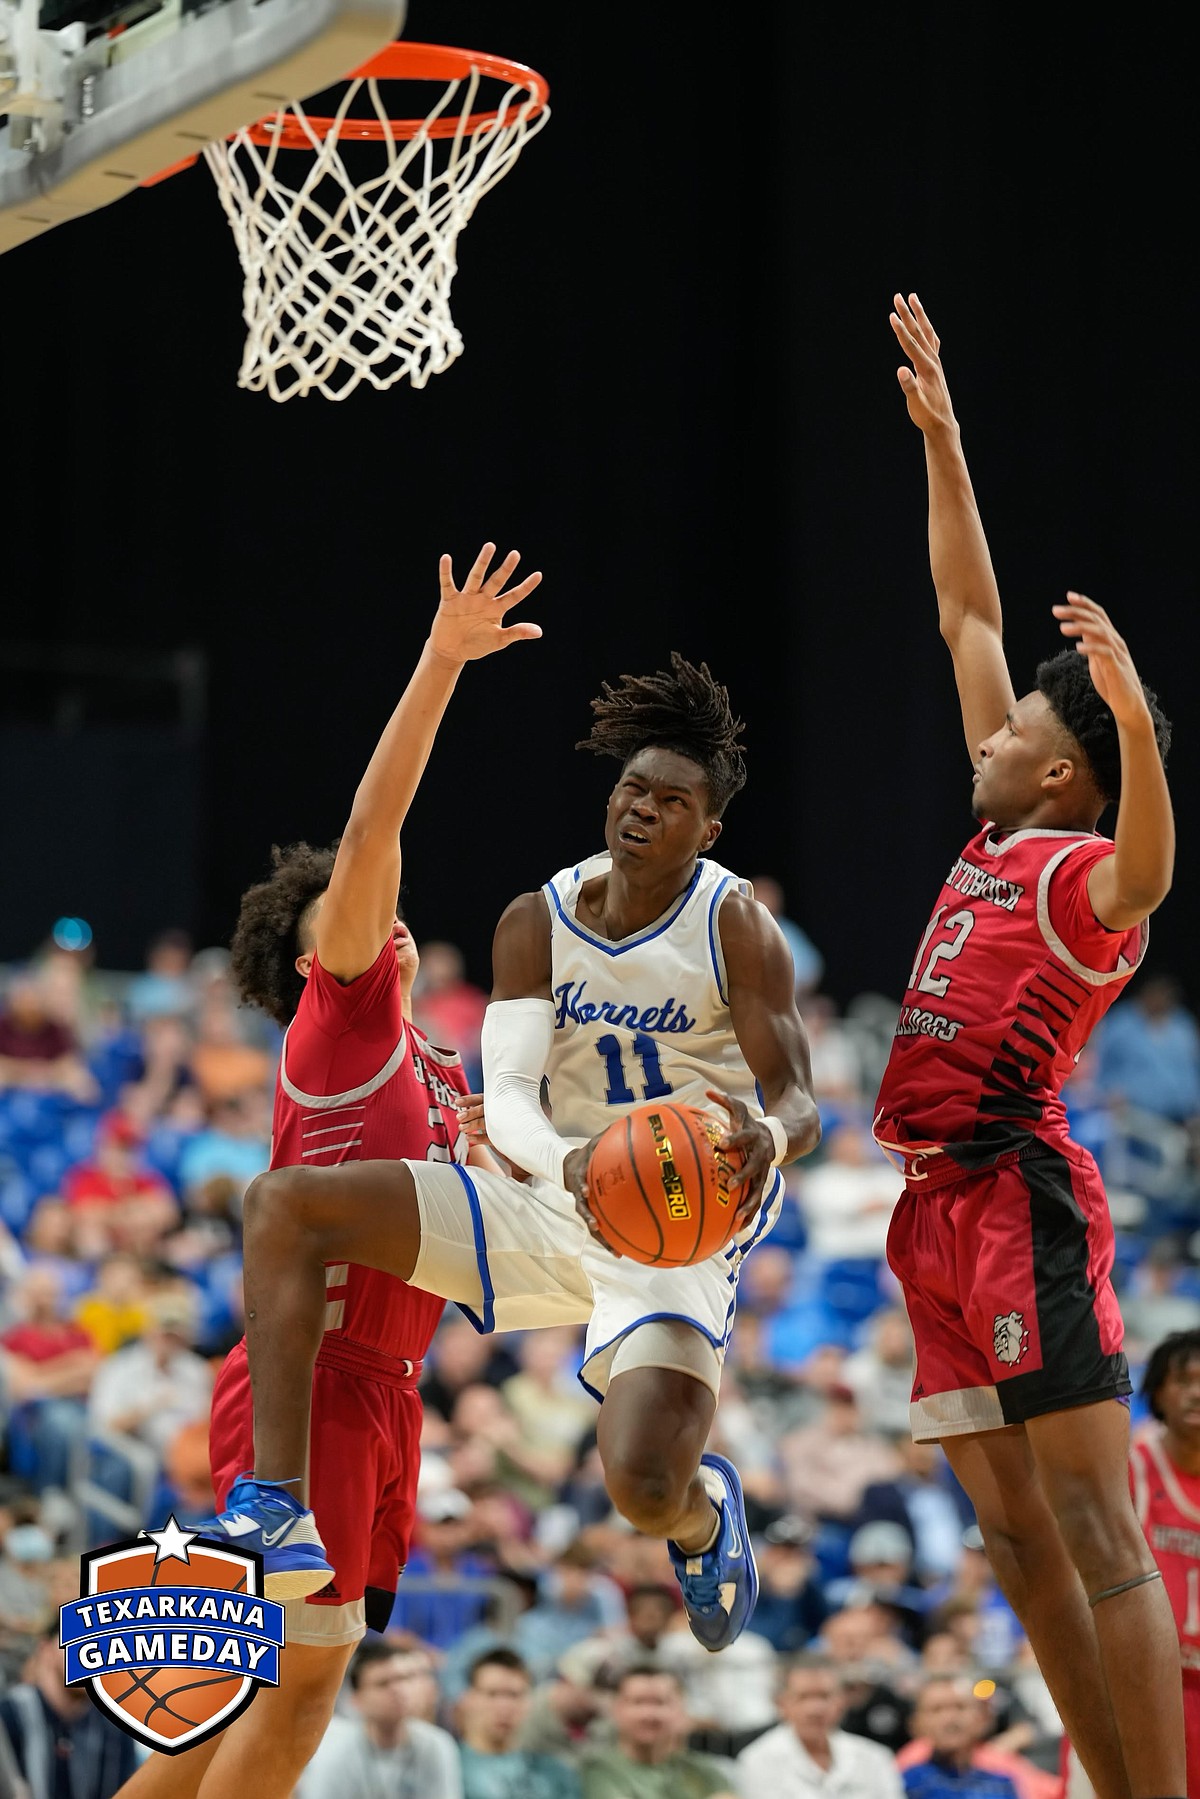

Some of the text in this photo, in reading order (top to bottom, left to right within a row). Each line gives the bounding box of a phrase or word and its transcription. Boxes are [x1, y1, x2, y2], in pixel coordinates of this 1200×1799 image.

[907, 903, 976, 998] 12
[555, 981, 697, 1033] Hornets
[595, 1032, 674, 1106] 11
